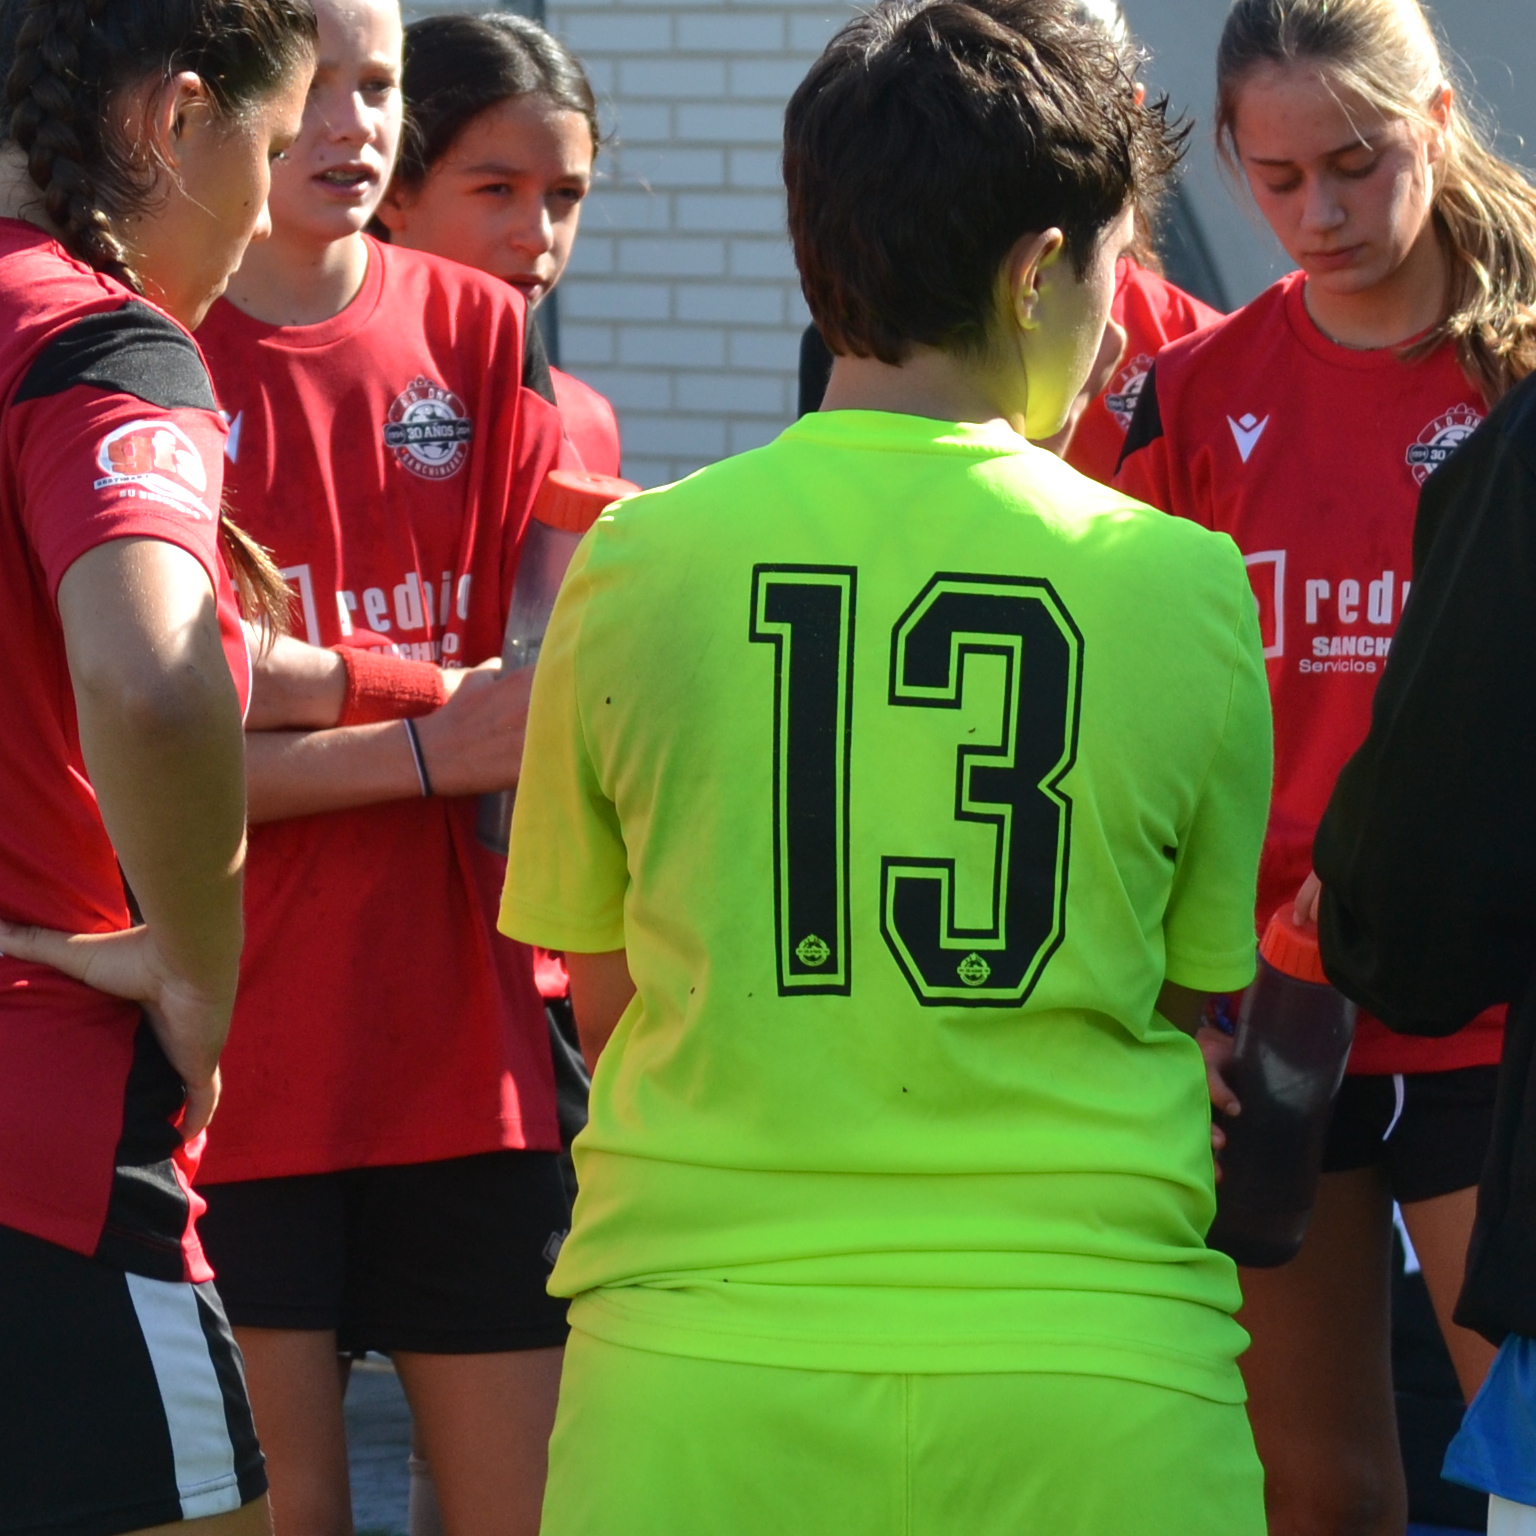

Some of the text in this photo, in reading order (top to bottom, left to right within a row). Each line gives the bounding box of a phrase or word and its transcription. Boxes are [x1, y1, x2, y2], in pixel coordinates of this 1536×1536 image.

[407, 427, 422, 440] 30
[1299, 658, 1377, 673] Servicios
[748, 563, 1085, 1008] 13
